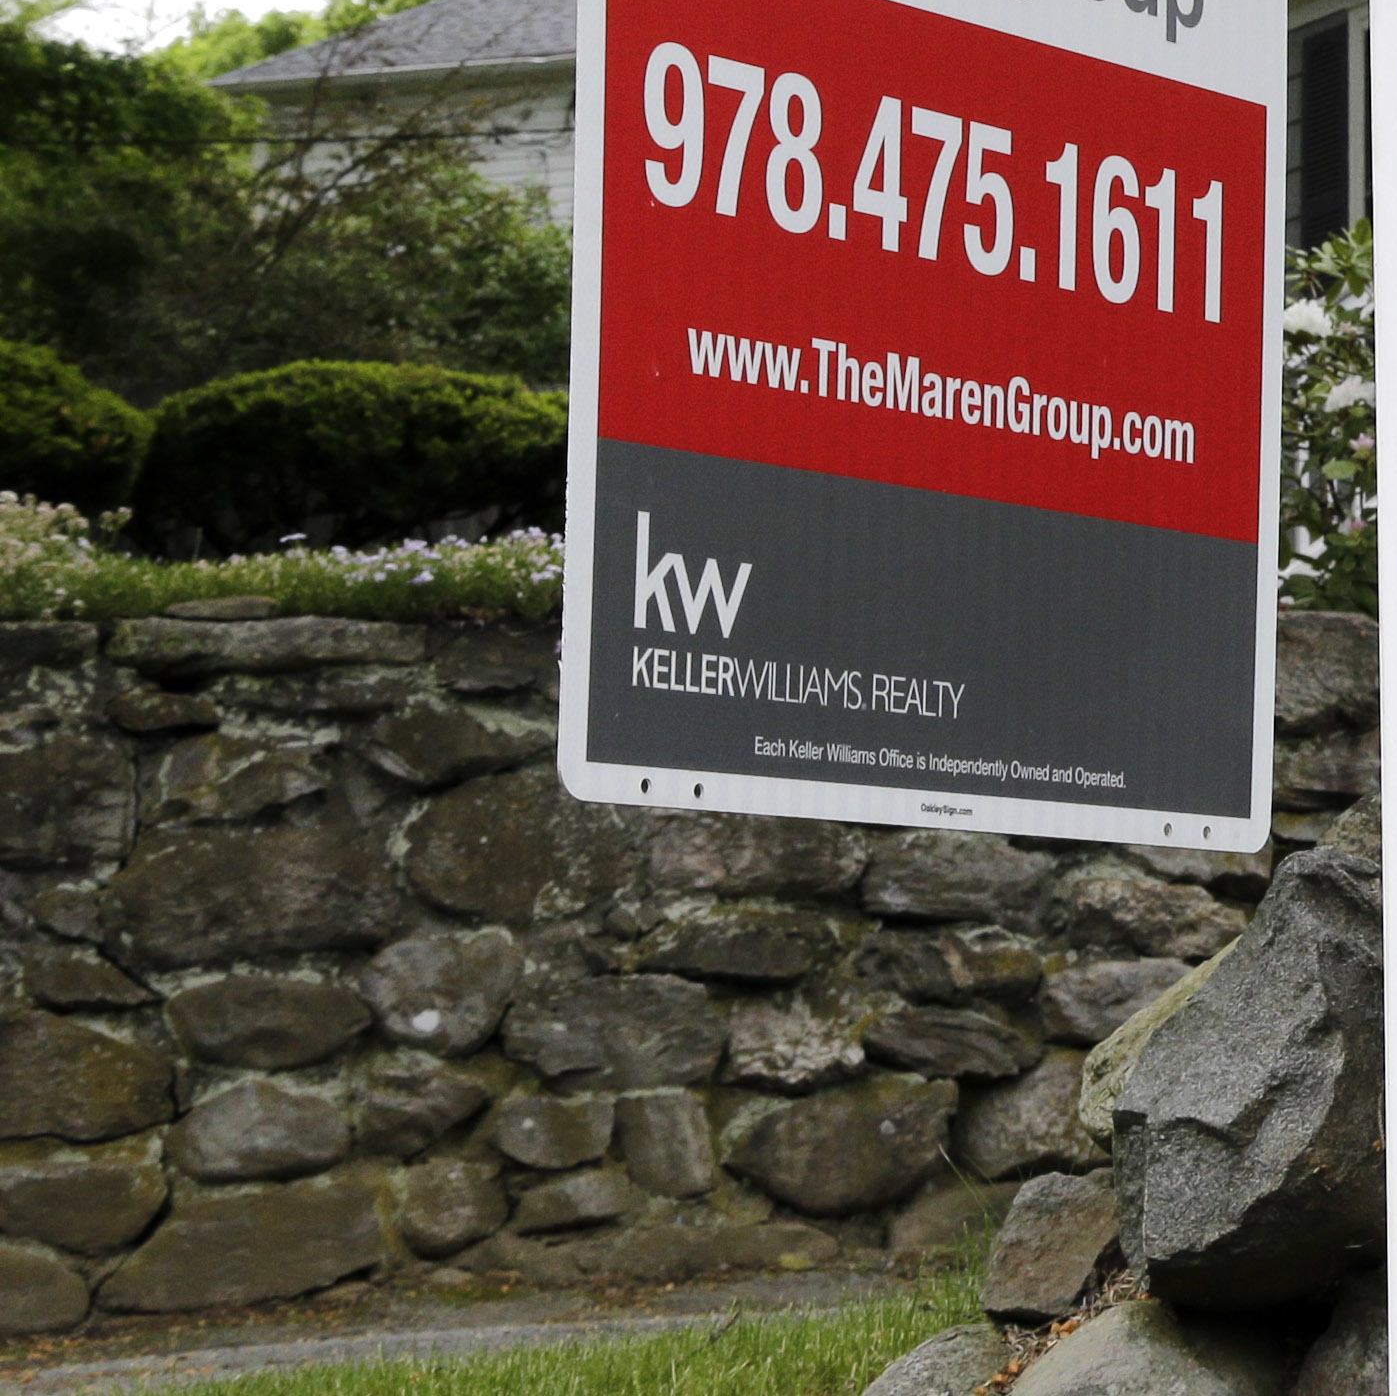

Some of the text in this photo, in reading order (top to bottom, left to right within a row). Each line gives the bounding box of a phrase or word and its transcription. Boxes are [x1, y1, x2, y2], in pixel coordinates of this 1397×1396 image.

[643, 41, 1224, 324] 978.475.1611
[687, 327, 1196, 464] www.TheMarenGroup.com
[633, 510, 753, 639] kw
[871, 673, 965, 719] REALTY
[754, 735, 1127, 789] Each Keller Williams Office is Independently Owned and Operated.
